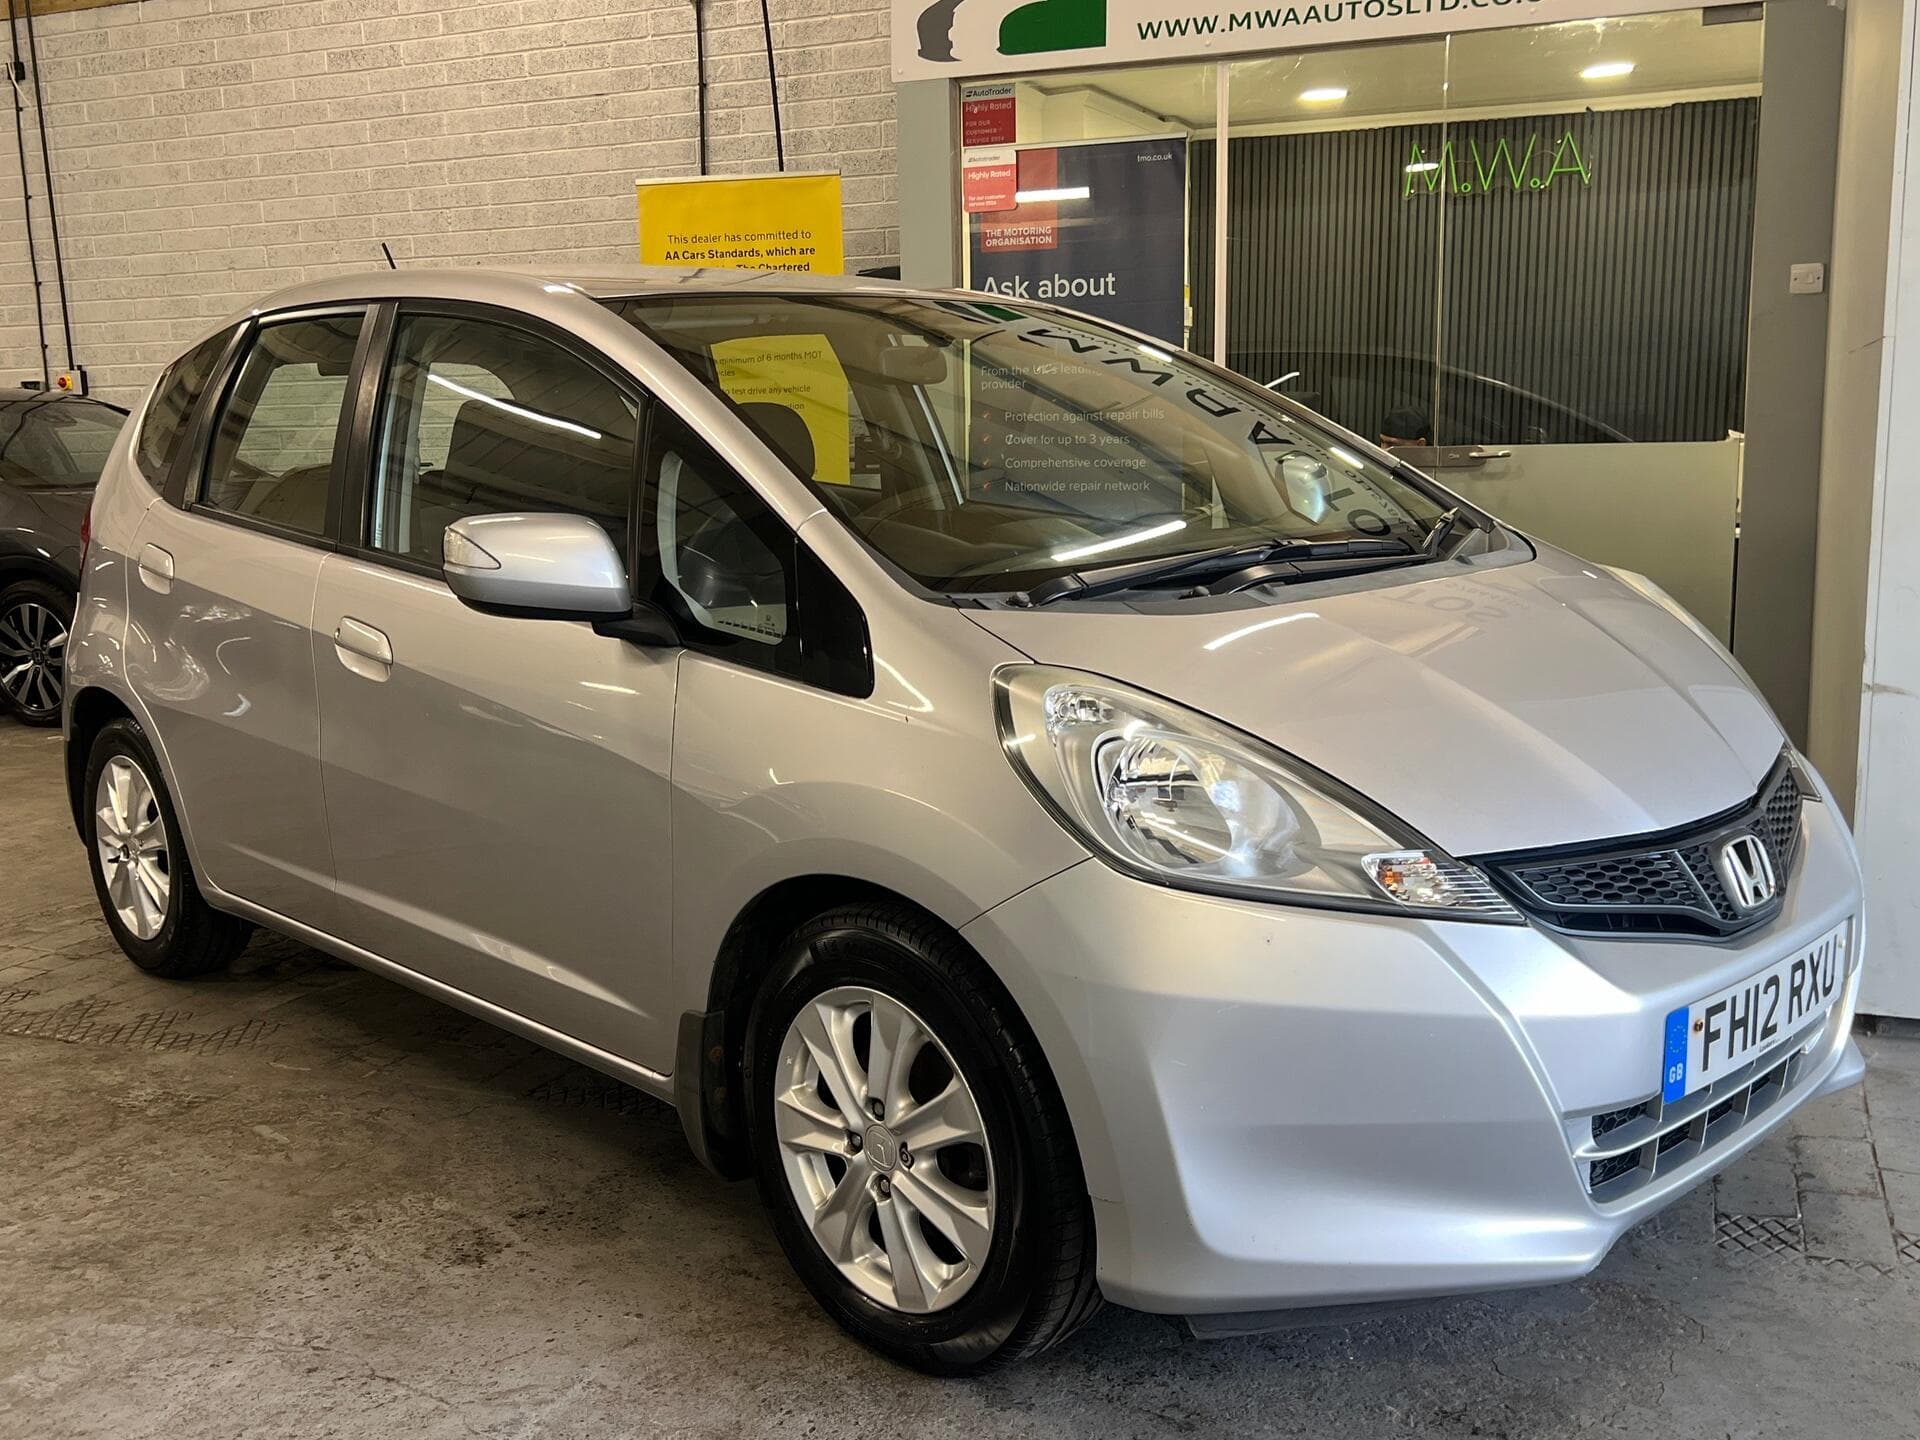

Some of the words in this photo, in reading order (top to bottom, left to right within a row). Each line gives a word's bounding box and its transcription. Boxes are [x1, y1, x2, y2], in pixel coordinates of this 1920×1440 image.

[1137, 0, 1541, 40] WWW.MWAAUTOSLTD..
[968, 171, 990, 181] Highly
[990, 169, 1011, 178] Rated
[668, 235, 688, 245] This
[691, 234, 721, 244] dealer
[724, 233, 741, 243] has
[744, 230, 798, 242] committed
[800, 231, 811, 239] to
[986, 229, 1002, 238] THE
[1004, 226, 1052, 236] MOTORING
[986, 236, 1052, 247] ORGANISATION
[665, 251, 680, 261] AA
[682, 250, 705, 260] Cars
[708, 247, 764, 259] Standards,
[766, 246, 796, 257] which
[799, 247, 816, 256] are
[983, 275, 1030, 299] Ask
[1037, 272, 1116, 299] about
[720, 357, 755, 365] minimum
[757, 354, 765, 362] of
[774, 352, 802, 361] months
[804, 351, 823, 360] MOT
[981, 366, 1008, 376] From
[1012, 365, 1030, 375] the
[732, 387, 746, 395] test
[747, 387, 767, 395] drive
[768, 387, 782, 397] any
[783, 384, 811, 394] vehicle
[981, 379, 1026, 392] provider
[1005, 411, 1060, 423] Protection
[1062, 411, 1104, 424] against
[1106, 411, 1138, 423] repair
[1142, 408, 1165, 420] bills
[1005, 434, 1037, 446] Cover
[1040, 434, 1054, 445] for
[1058, 436, 1072, 447] up
[1075, 434, 1087, 444] to
[1089, 433, 1097, 444] 3
[1100, 435, 1130, 447] years
[1004, 457, 1091, 469] Comprehensive
[1093, 457, 1147, 470] coverage
[1005, 481, 1065, 492] Nationwide
[1069, 481, 1101, 493] repair
[1104, 480, 1150, 491] network
[1702, 974, 1780, 1072] FH12
[1788, 934, 1838, 1025] RXU
[1669, 1062, 1684, 1083] GB
